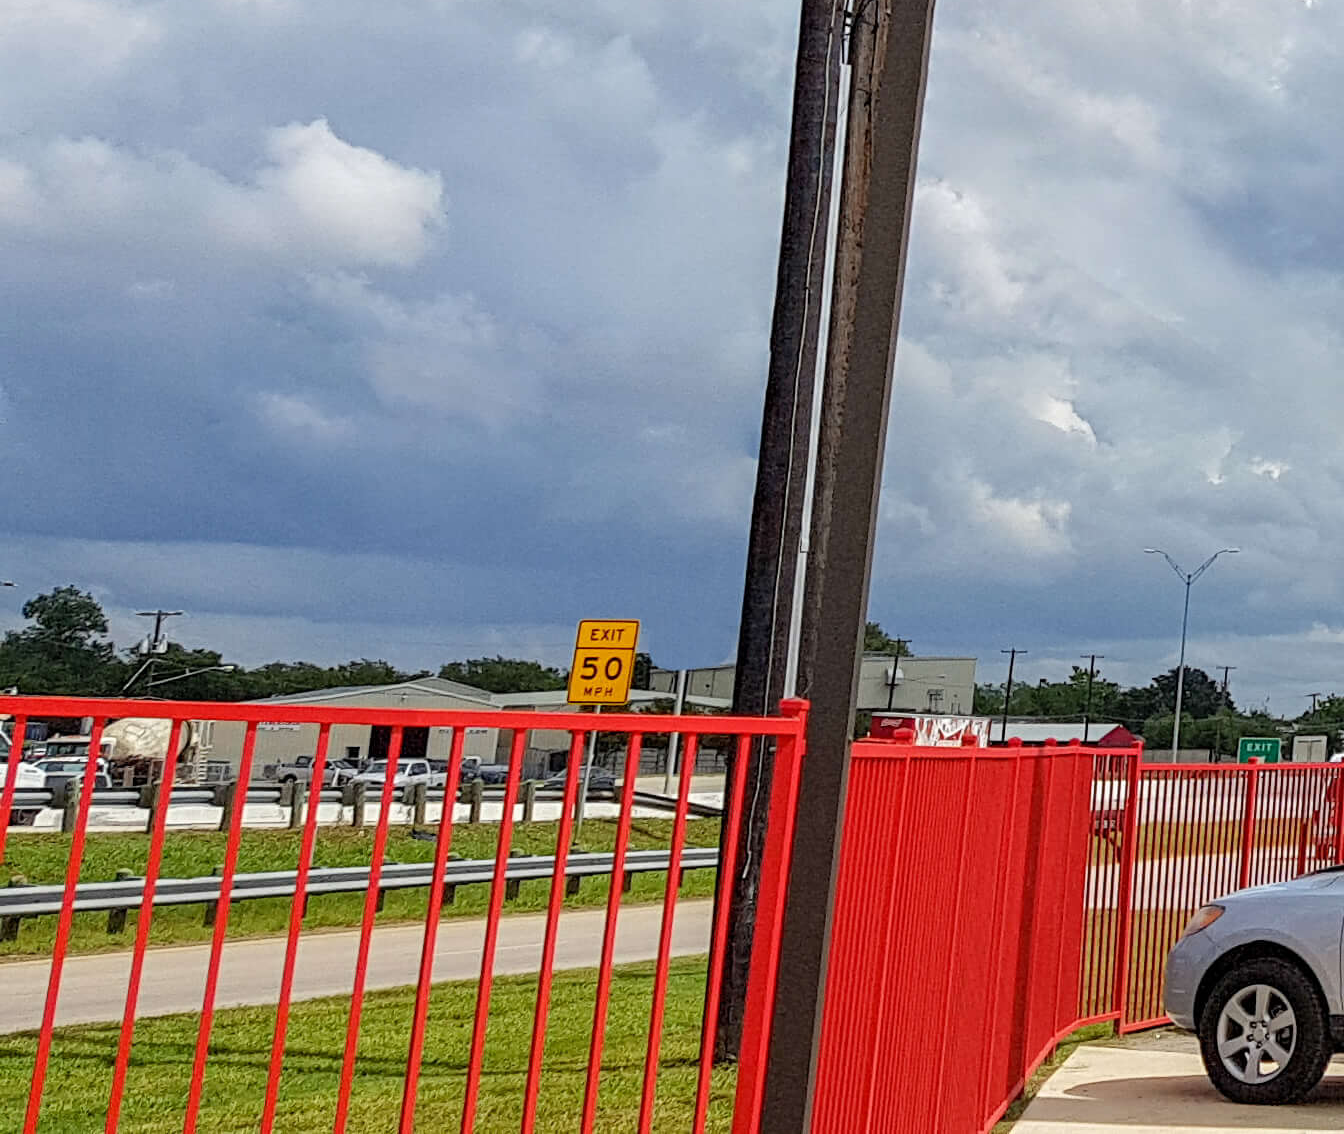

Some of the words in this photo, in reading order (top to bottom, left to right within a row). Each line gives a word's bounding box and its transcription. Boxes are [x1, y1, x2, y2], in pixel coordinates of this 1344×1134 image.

[590, 628, 625, 642] EXIT
[580, 656, 623, 681] 50
[583, 686, 614, 697] MPH
[1246, 742, 1273, 753] EXIT
